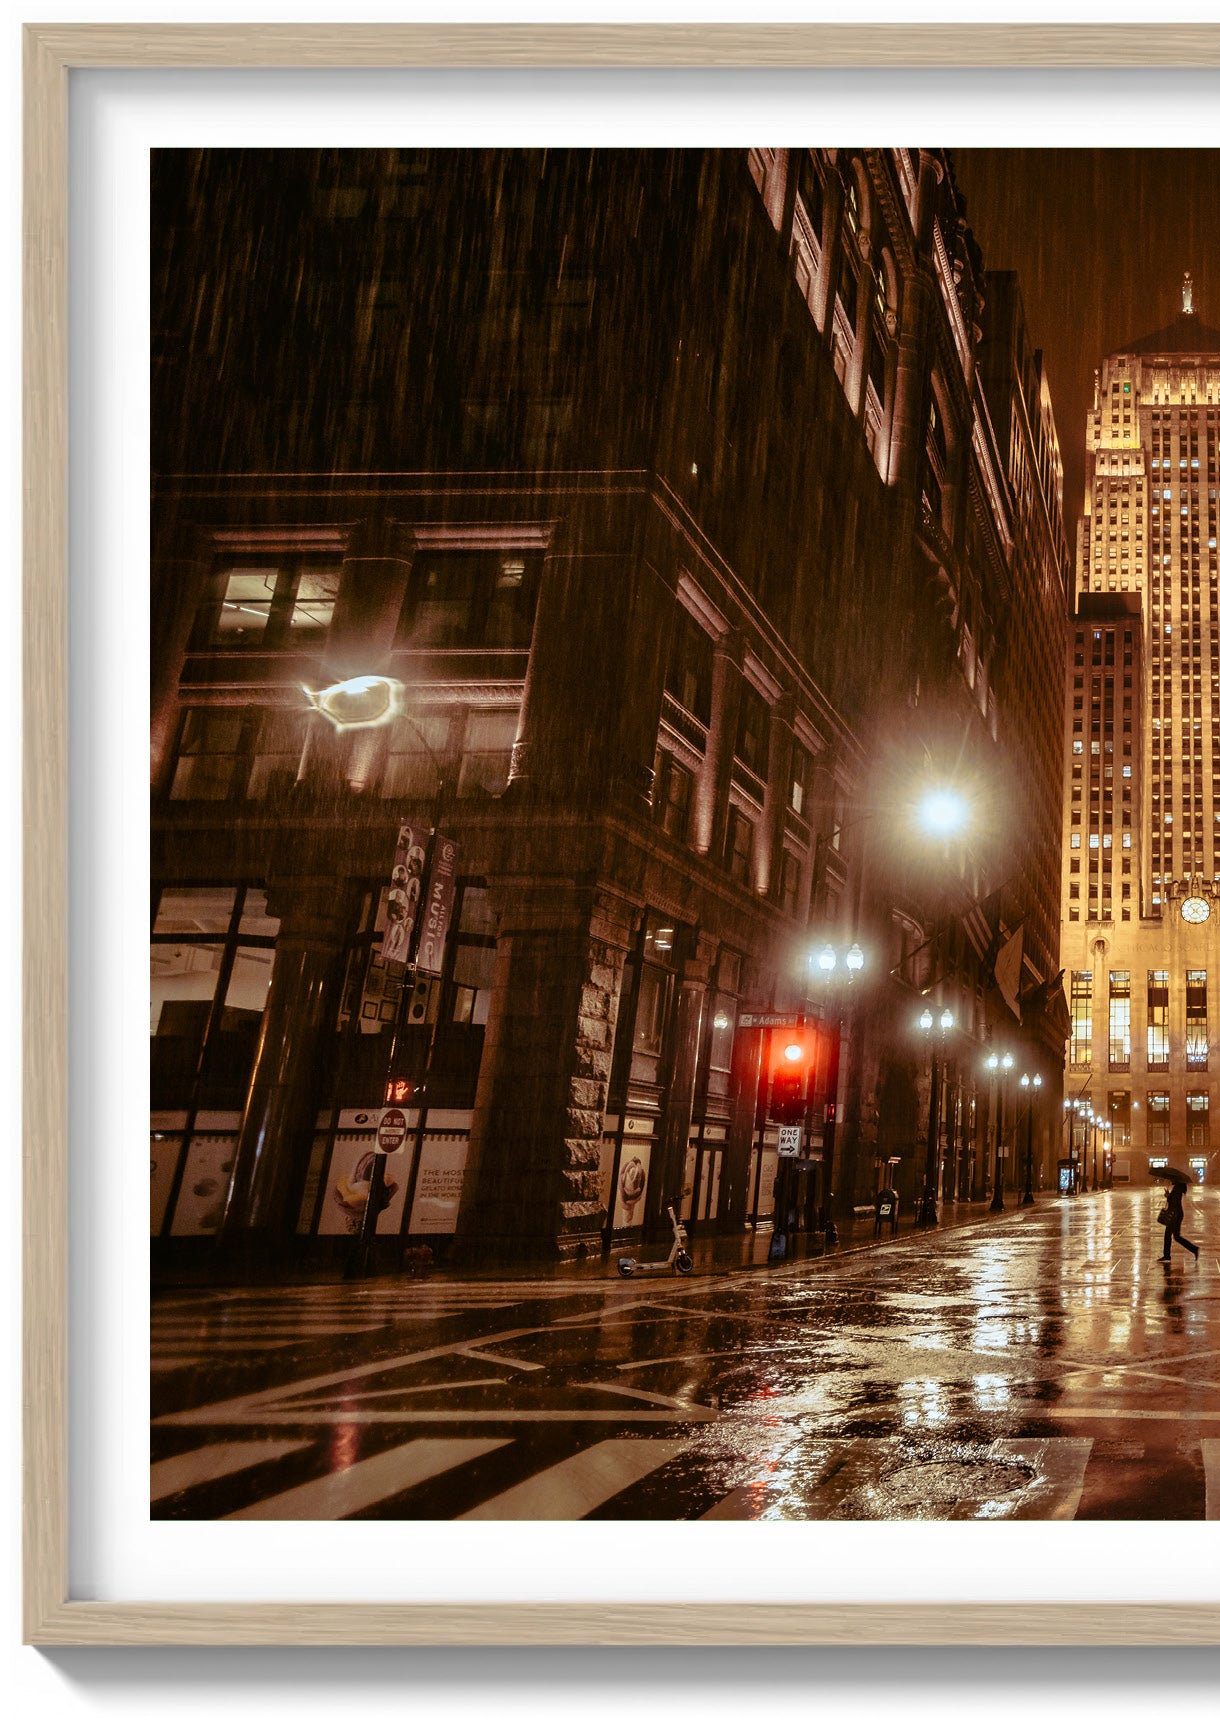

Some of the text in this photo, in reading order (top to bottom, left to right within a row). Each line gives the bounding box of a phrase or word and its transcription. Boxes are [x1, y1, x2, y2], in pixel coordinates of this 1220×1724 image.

[424, 882, 445, 955] MUSIC
[758, 1015, 787, 1026] Adams
[383, 1117, 392, 1125] DO
[393, 1117, 405, 1126] NOT
[382, 1136, 399, 1145] ENTER
[780, 1136, 798, 1144] WAY
